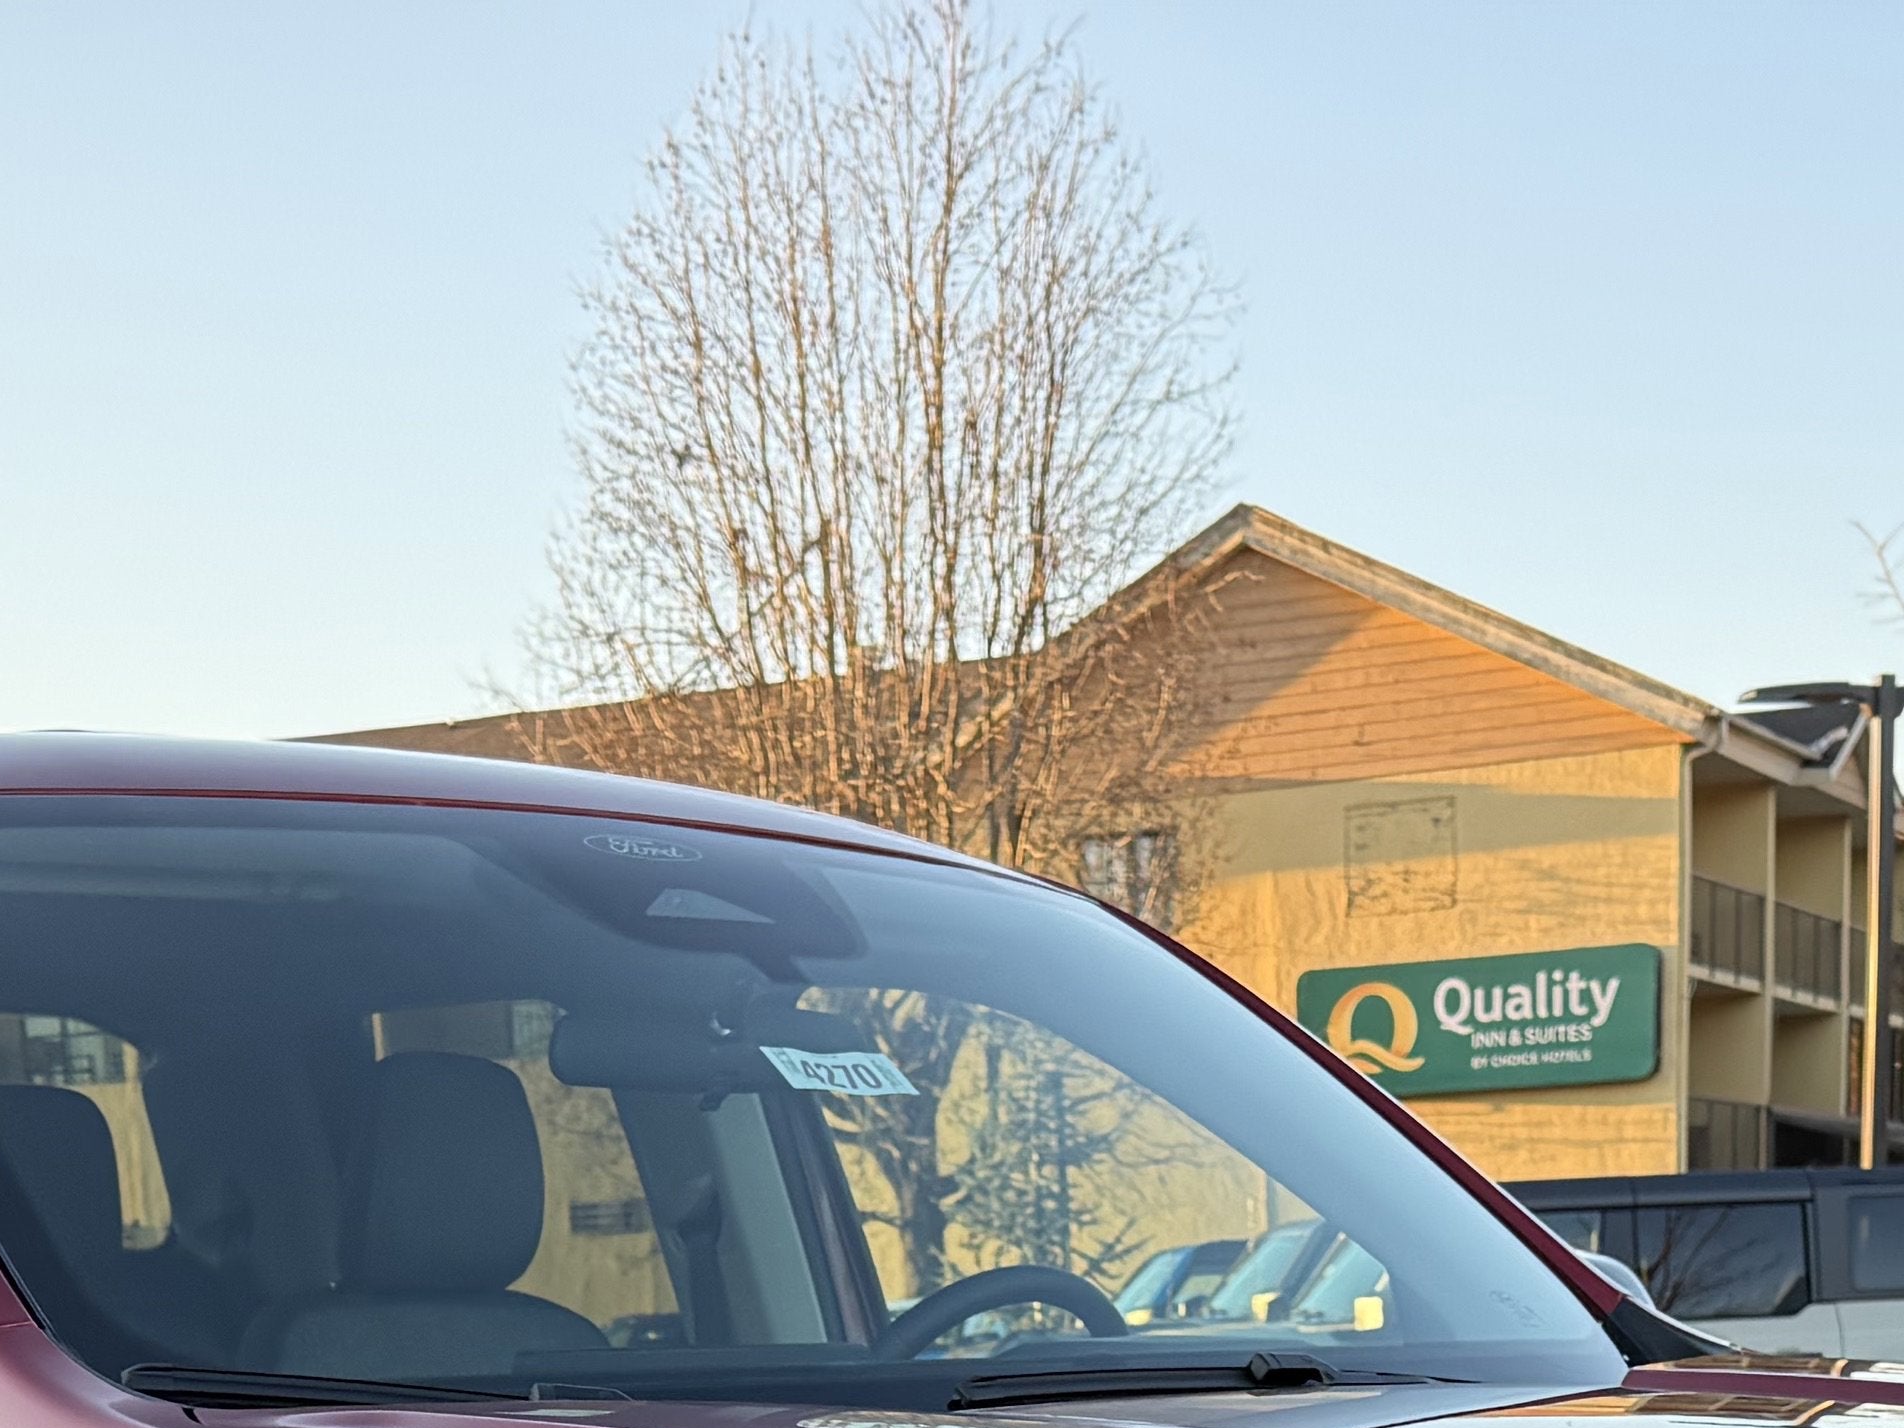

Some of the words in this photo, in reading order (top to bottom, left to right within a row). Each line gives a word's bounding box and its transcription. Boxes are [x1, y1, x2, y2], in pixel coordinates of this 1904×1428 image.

[608, 837, 684, 858] Ford
[1433, 969, 1620, 1035] Quality
[1471, 1029, 1507, 1049] INN
[1508, 1027, 1522, 1046] &
[1524, 1023, 1593, 1045] SUITES
[800, 1059, 884, 1090] 4270
